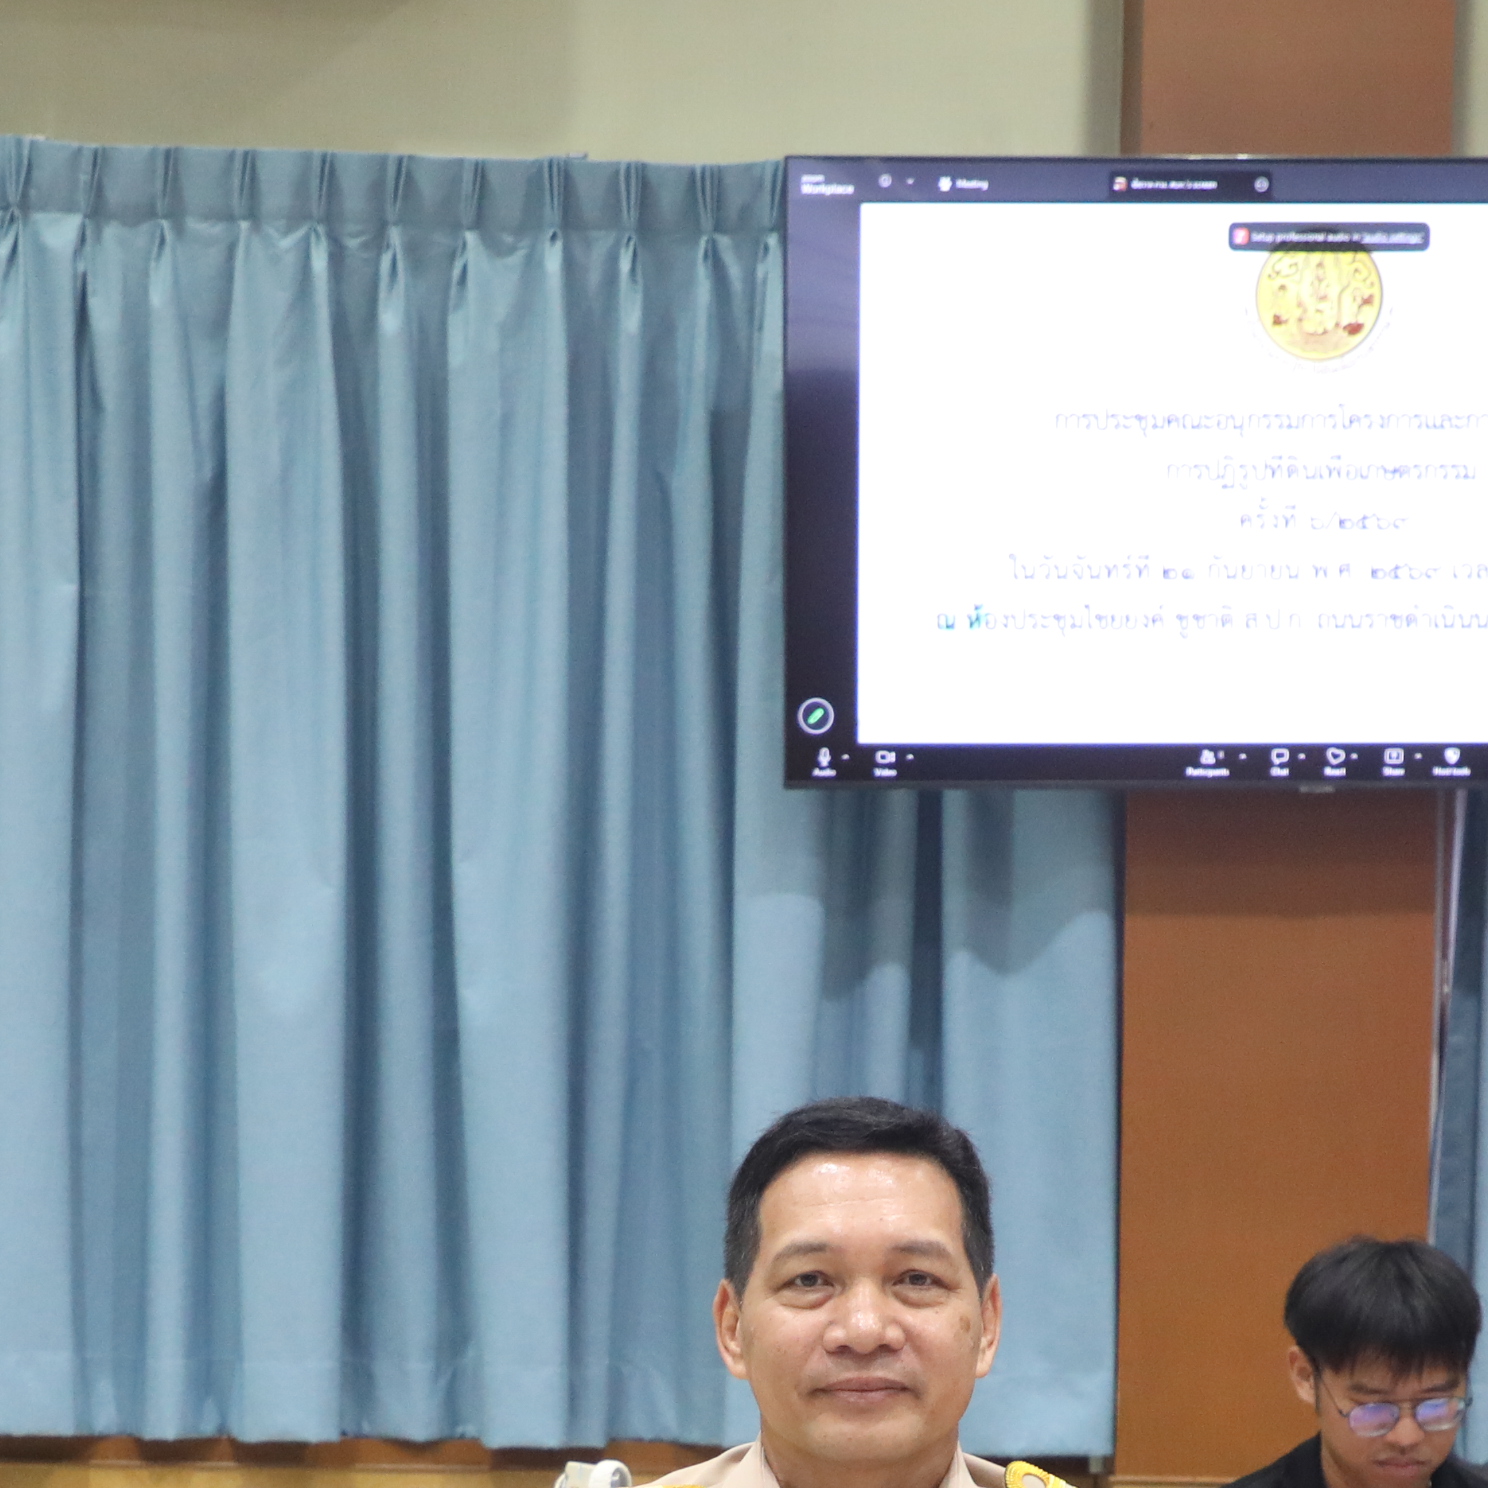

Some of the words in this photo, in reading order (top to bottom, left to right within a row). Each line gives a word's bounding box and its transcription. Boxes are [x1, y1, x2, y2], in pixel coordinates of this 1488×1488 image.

[800, 182, 855, 196] Workplace
[1167, 454, 1477, 490] การปฏิรูปทีดินเพือเกษตรกรรม
[1241, 496, 1296, 529] ครั้งที
[1009, 554, 1149, 579] ในวันจันทร์ที
[1208, 555, 1300, 580] กันยายน
